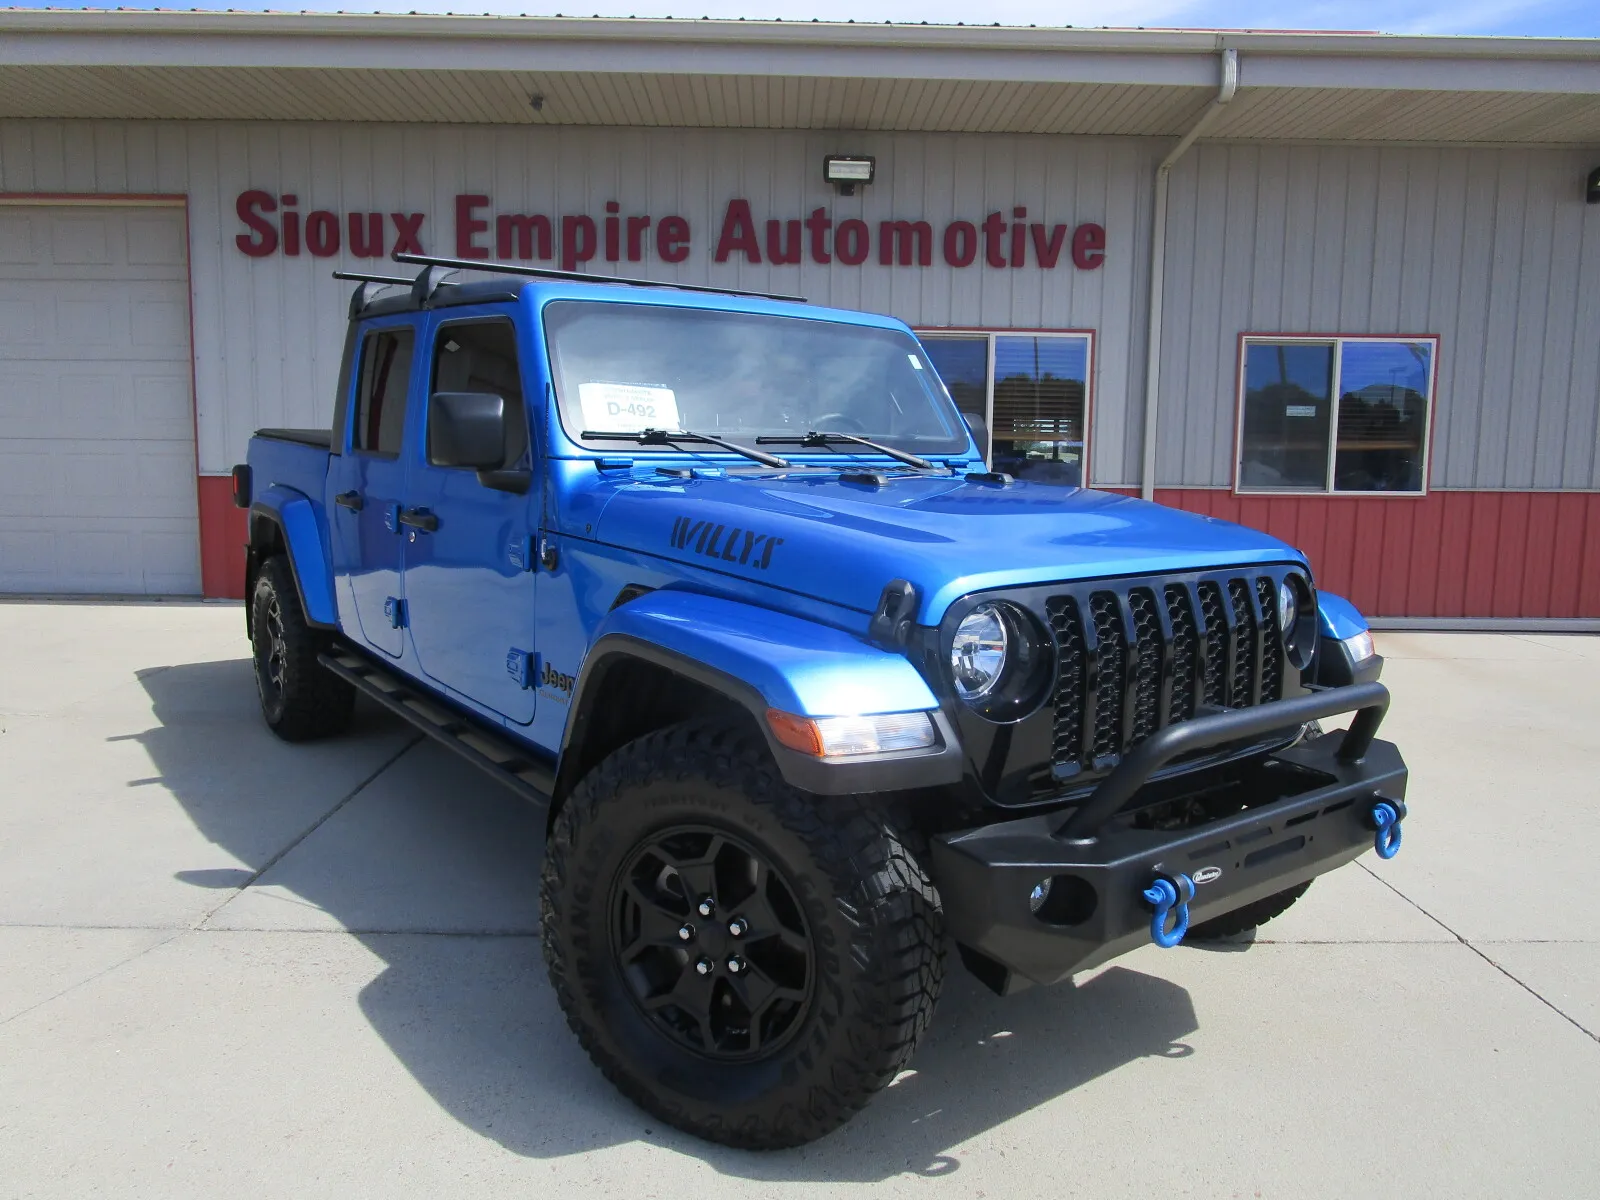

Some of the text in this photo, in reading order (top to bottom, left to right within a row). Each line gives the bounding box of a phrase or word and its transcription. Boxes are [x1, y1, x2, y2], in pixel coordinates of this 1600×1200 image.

[235, 189, 1106, 271] Sioux Empire Automotive
[607, 401, 656, 418] D-492
[670, 515, 784, 570] WILLYS
[541, 661, 576, 698] Jeep
